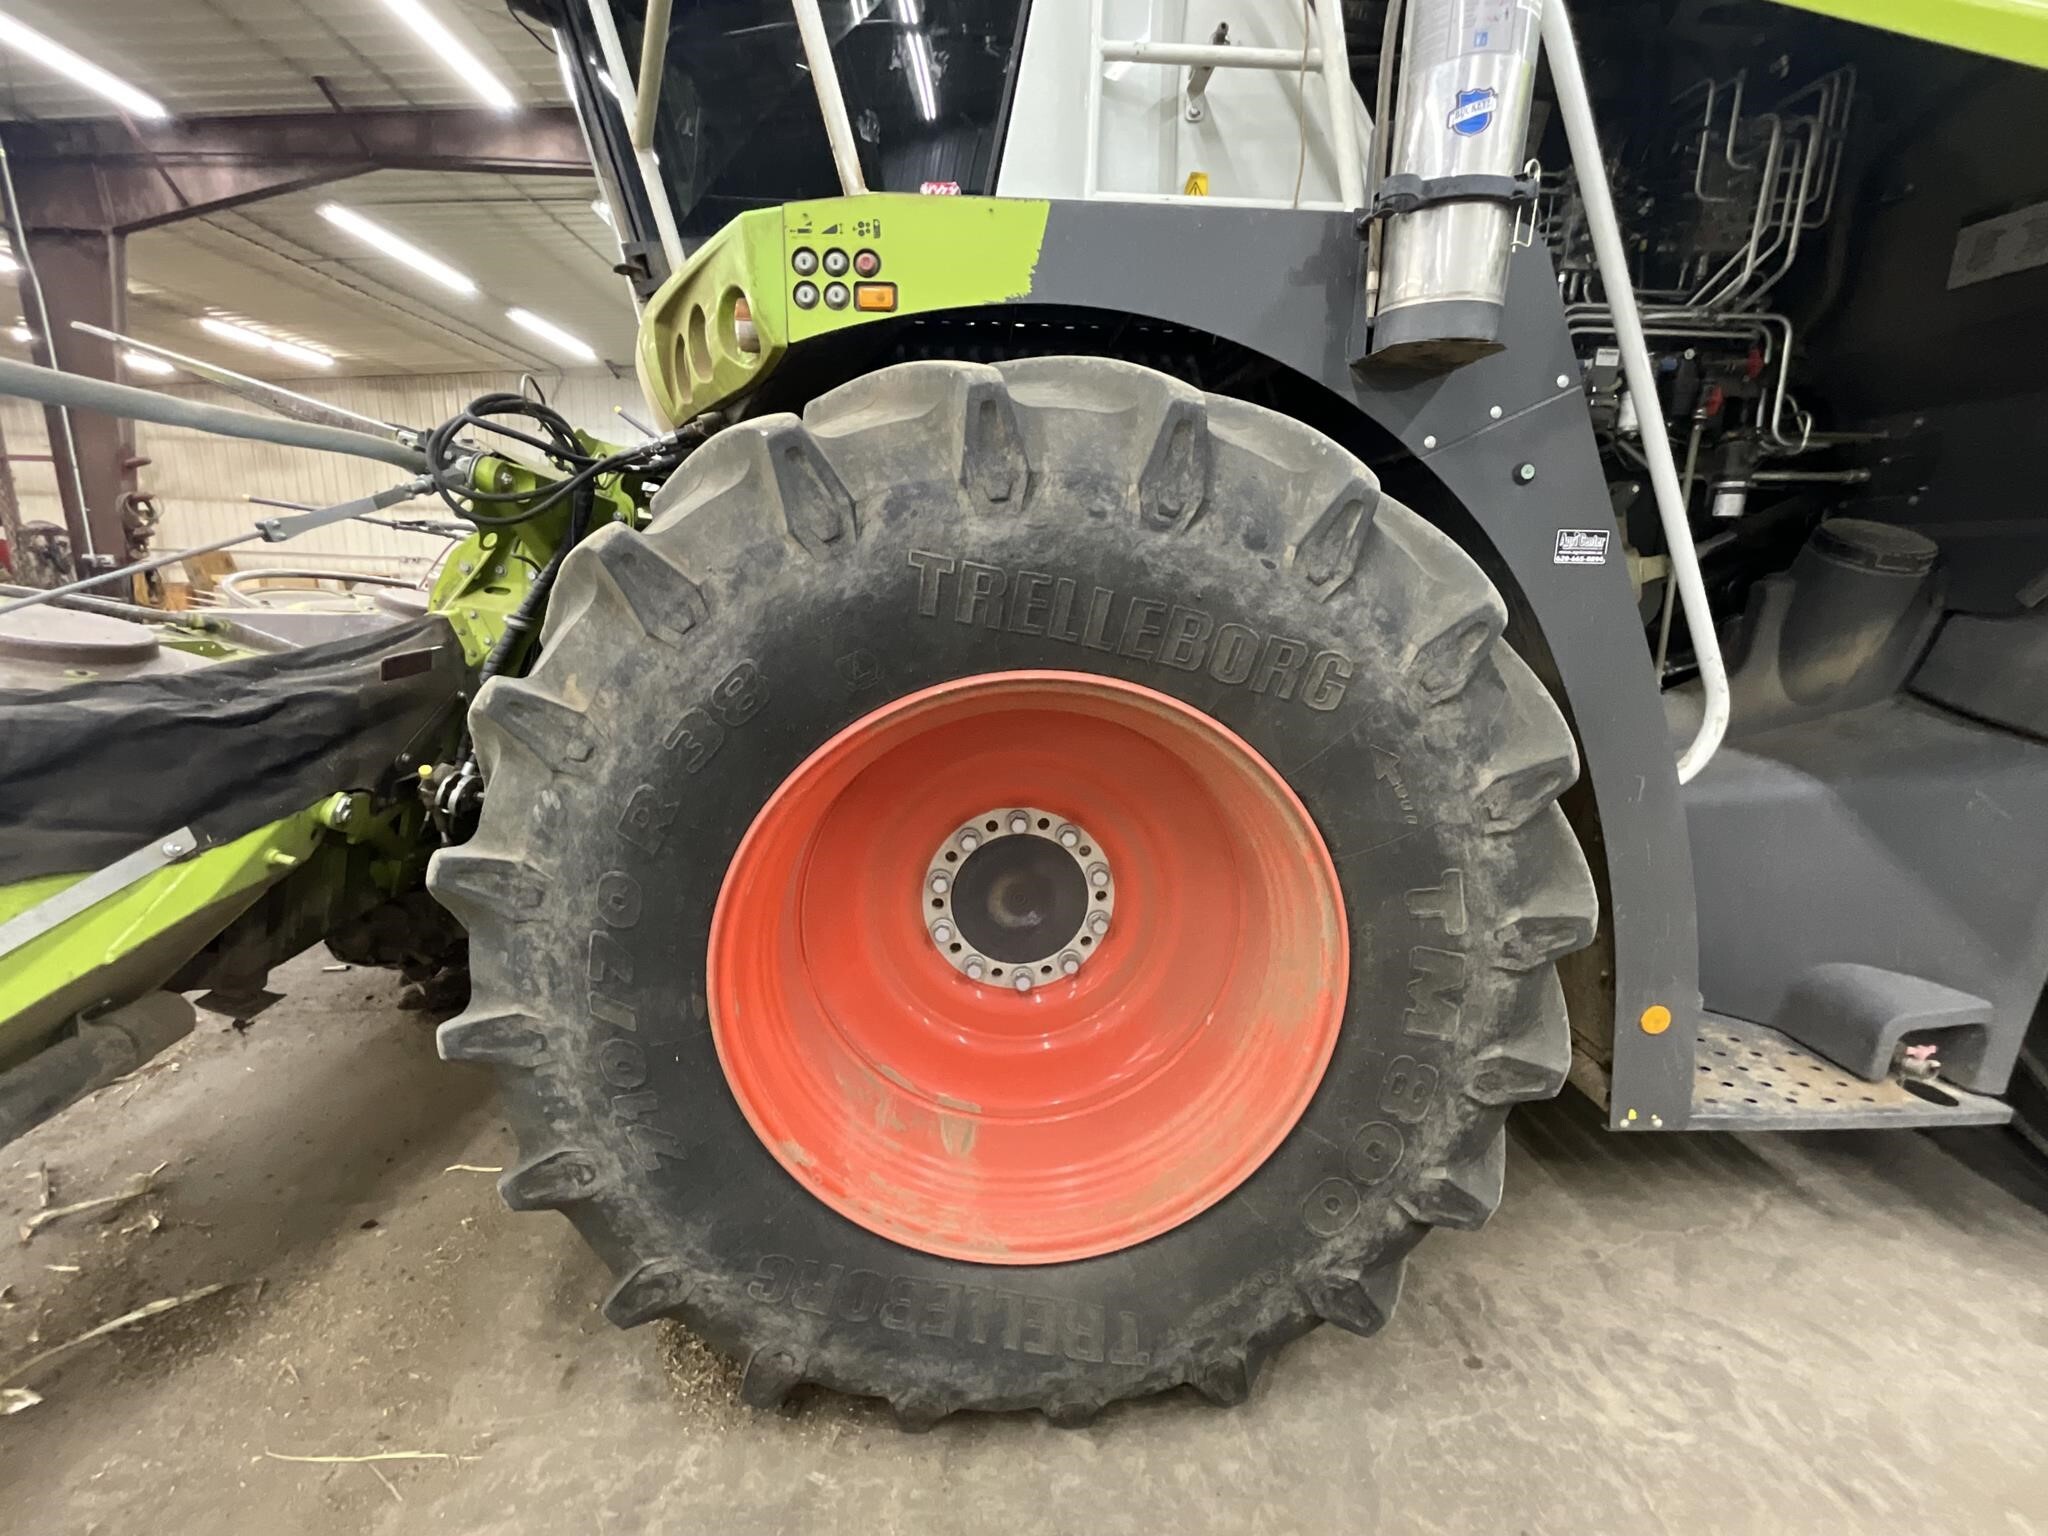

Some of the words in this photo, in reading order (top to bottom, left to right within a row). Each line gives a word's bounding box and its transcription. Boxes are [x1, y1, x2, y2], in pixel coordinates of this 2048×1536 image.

[907, 549, 1354, 712] TRELLEBORG
[616, 783, 680, 857] R
[663, 657, 771, 775] 38
[1402, 867, 1469, 1042] TM
[1302, 1054, 1439, 1239] 800
[746, 1254, 1151, 1367] TRELLEBORG
